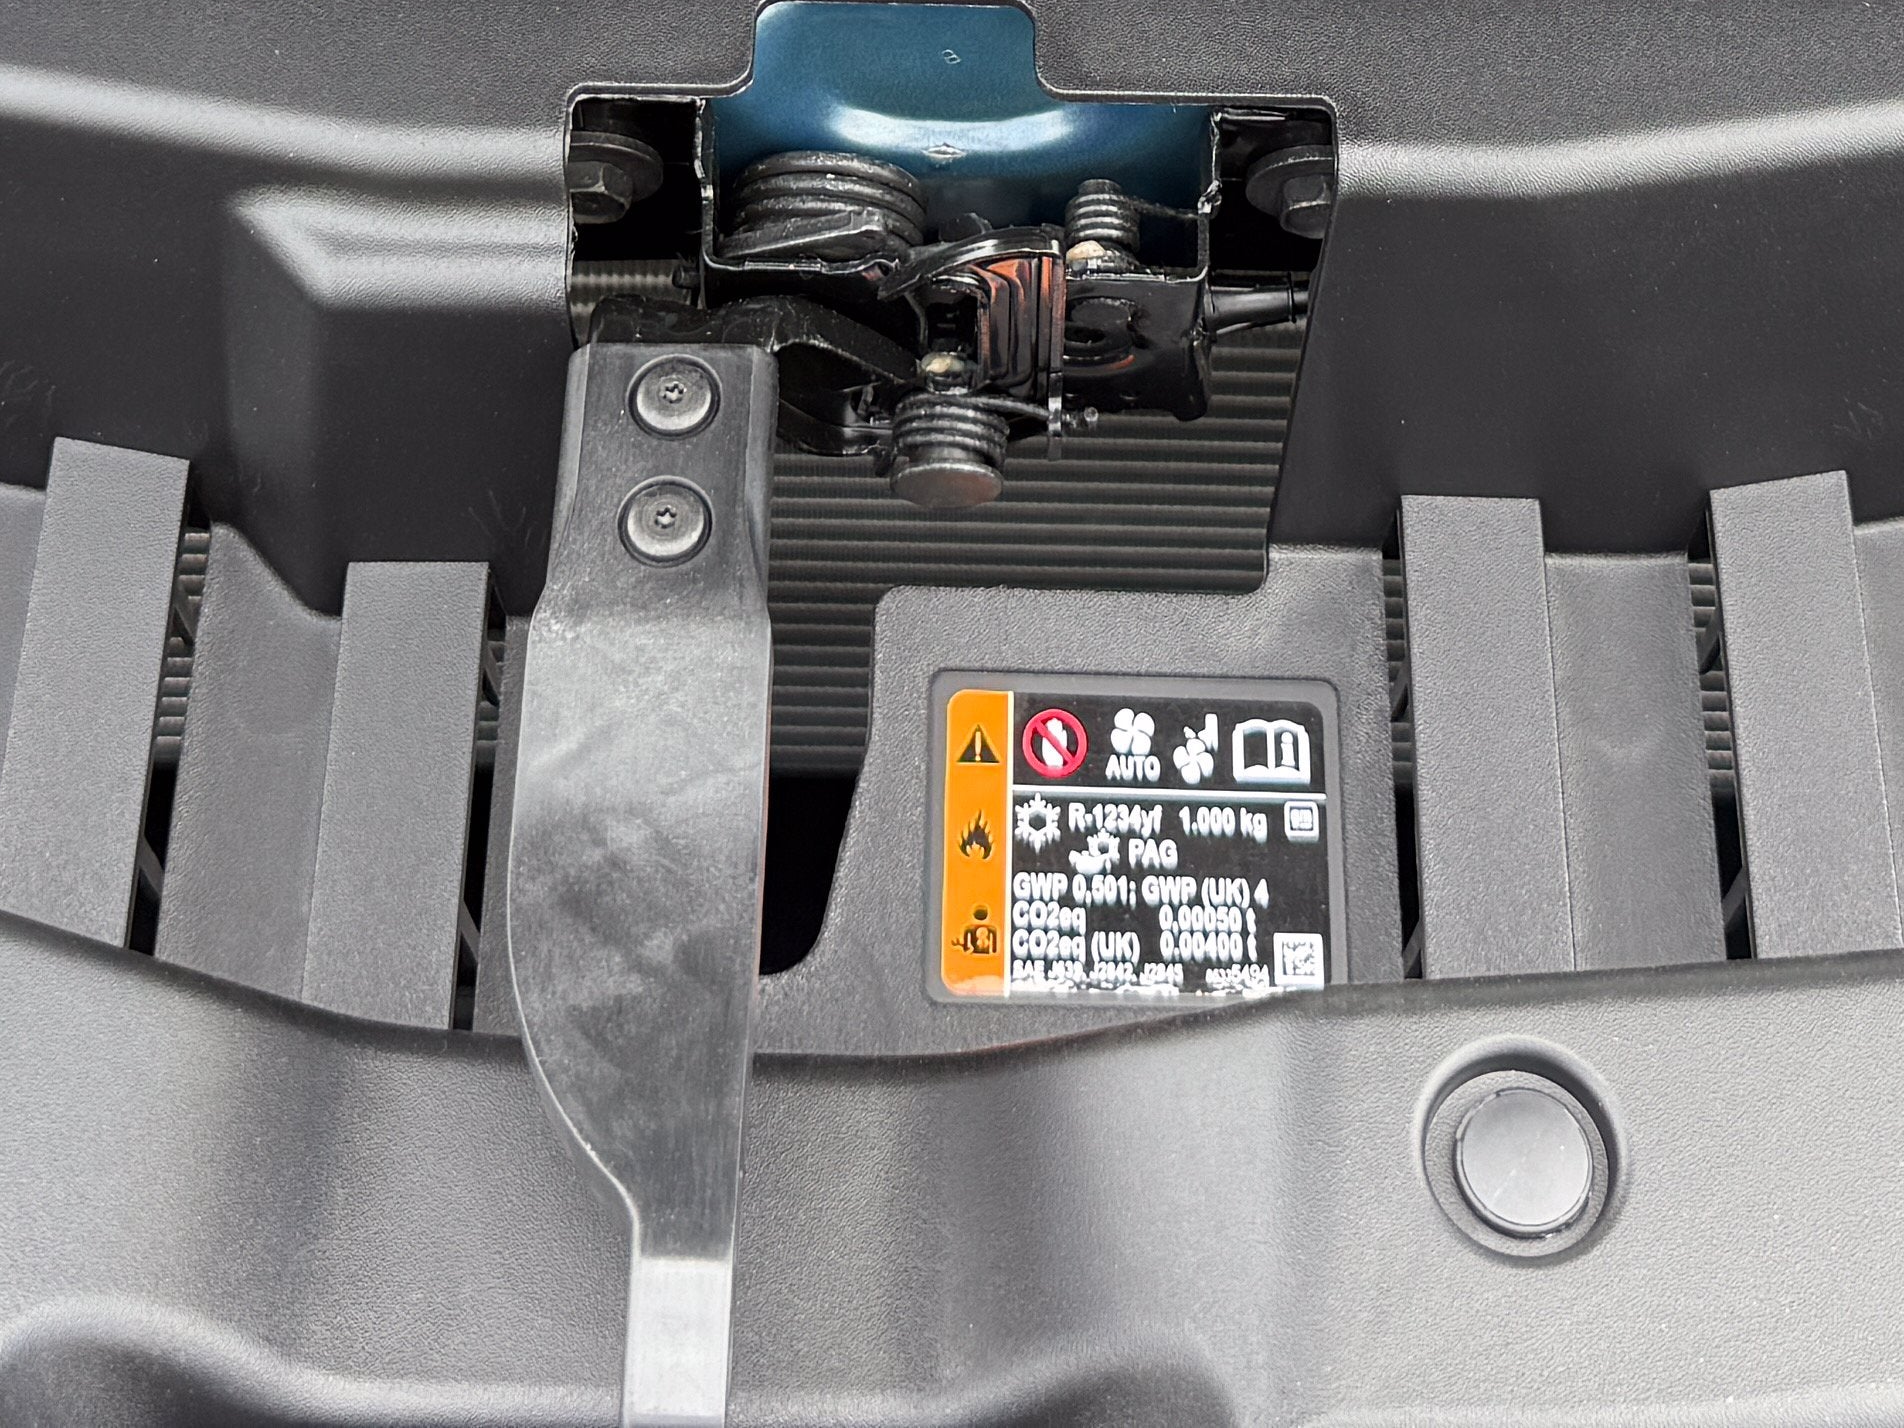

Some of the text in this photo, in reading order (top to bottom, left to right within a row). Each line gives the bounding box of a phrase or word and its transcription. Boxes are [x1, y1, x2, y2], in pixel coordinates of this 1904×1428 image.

[1105, 754, 1161, 781] AUTO
[1069, 802, 1163, 837] R-1234yf
[1179, 806, 1236, 835] 1.000
[1240, 807, 1268, 842] kg
[1128, 838, 1178, 869] PAG
[1012, 871, 1069, 901] GWP
[1142, 875, 1197, 907] GWP
[1201, 877, 1250, 908] (UK)
[1254, 878, 1269, 909] 4
[1013, 900, 1087, 935] CO2eq
[1246, 907, 1256, 933] t
[1013, 929, 1086, 965] CO2eq
[1091, 931, 1140, 966] (UK)
[1246, 933, 1257, 962] t
